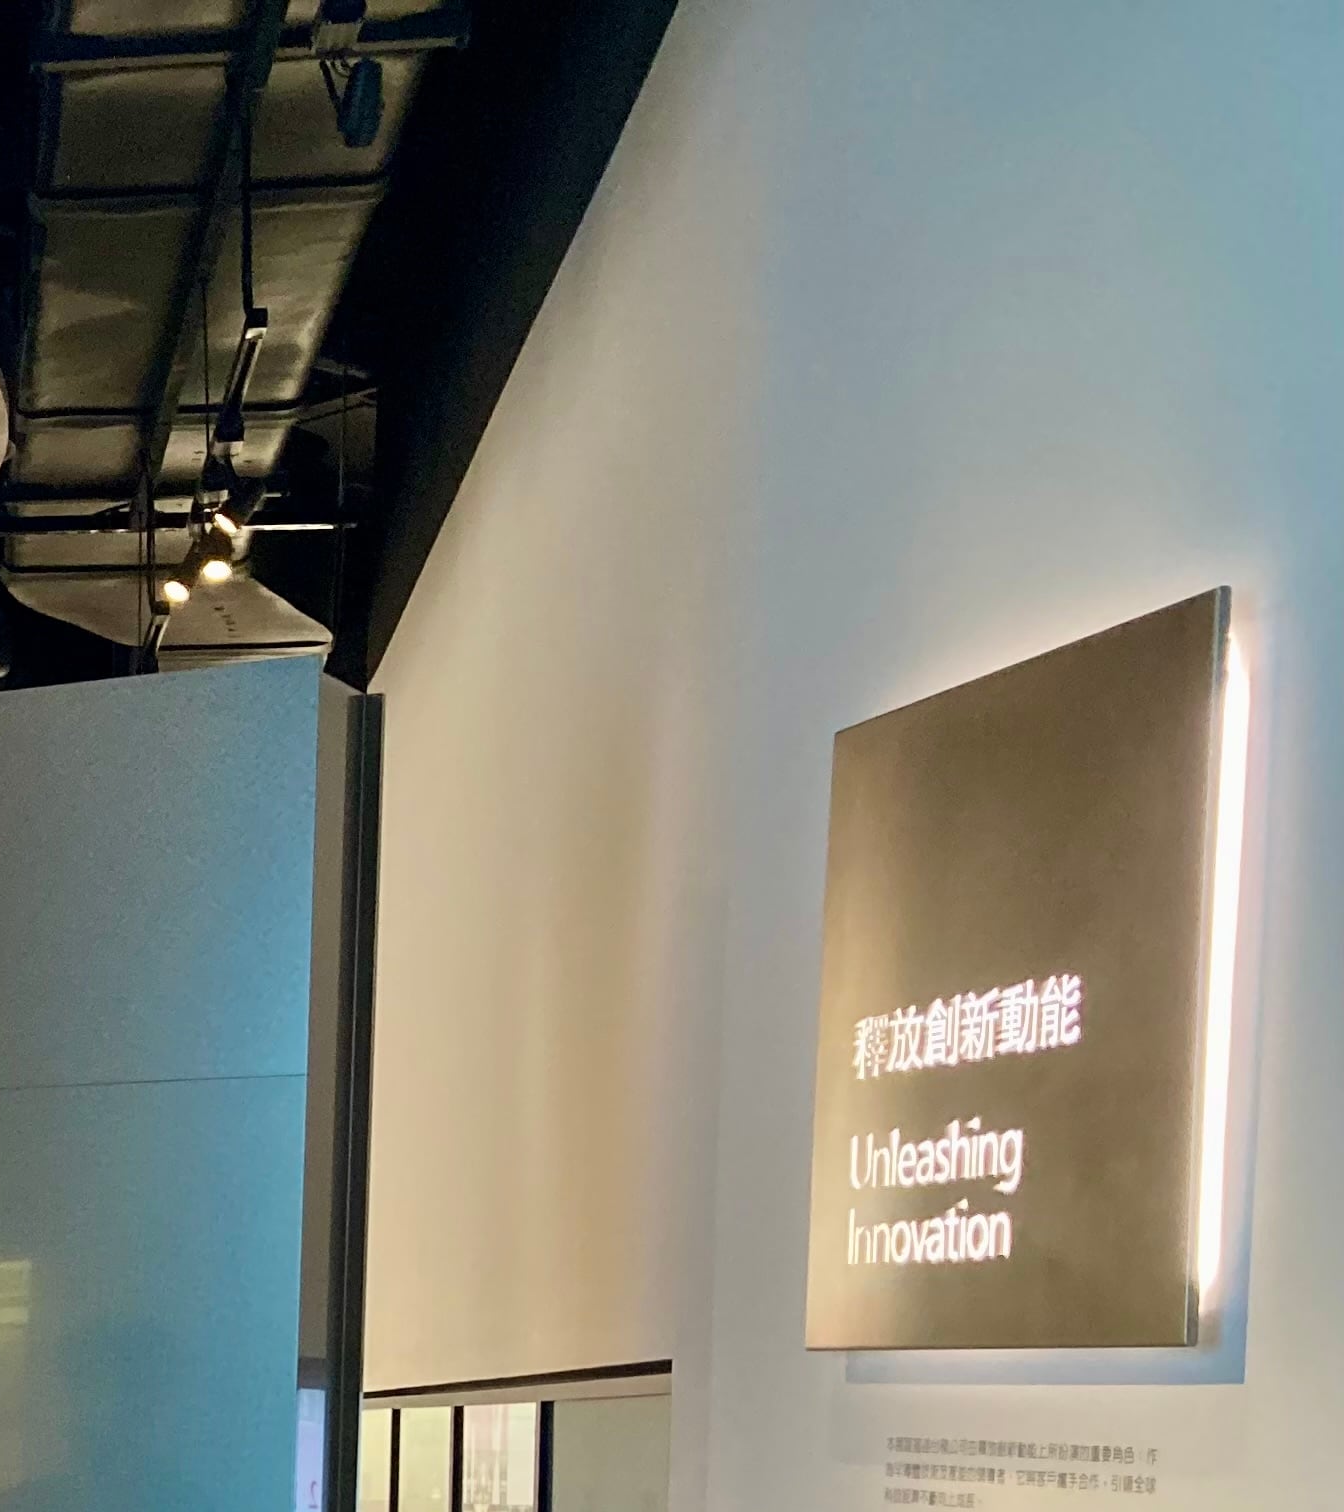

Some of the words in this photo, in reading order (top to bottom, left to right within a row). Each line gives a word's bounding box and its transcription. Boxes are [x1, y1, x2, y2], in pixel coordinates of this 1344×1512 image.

[852, 973, 1083, 1080] 釋放創新動能
[849, 1116, 1024, 1194] Unleashing
[847, 1199, 1012, 1265] Innovation
